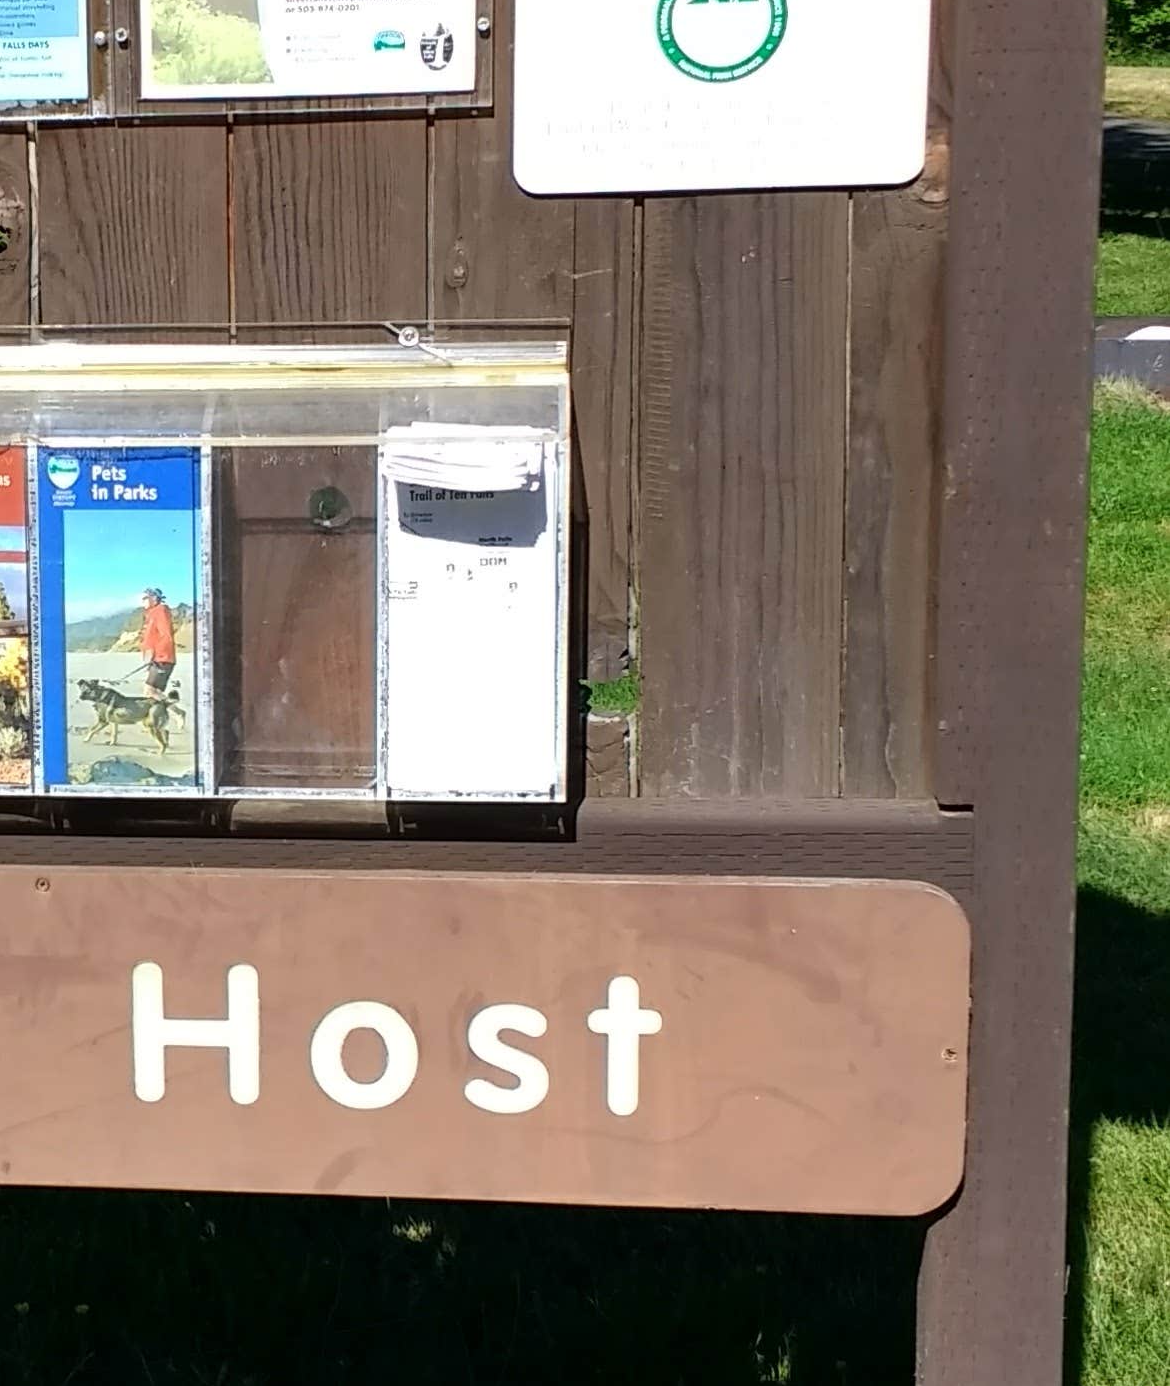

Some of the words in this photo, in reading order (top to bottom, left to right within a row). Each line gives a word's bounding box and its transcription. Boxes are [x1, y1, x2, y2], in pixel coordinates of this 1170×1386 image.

[2, 41, 26, 49] FALLS
[28, 40, 50, 49] DAYS
[91, 465, 127, 482] Pets
[91, 484, 108, 501] in
[114, 484, 158, 501] Parks
[409, 490, 433, 502] Trail
[435, 490, 446, 501] of
[132, 962, 664, 1116] Host
